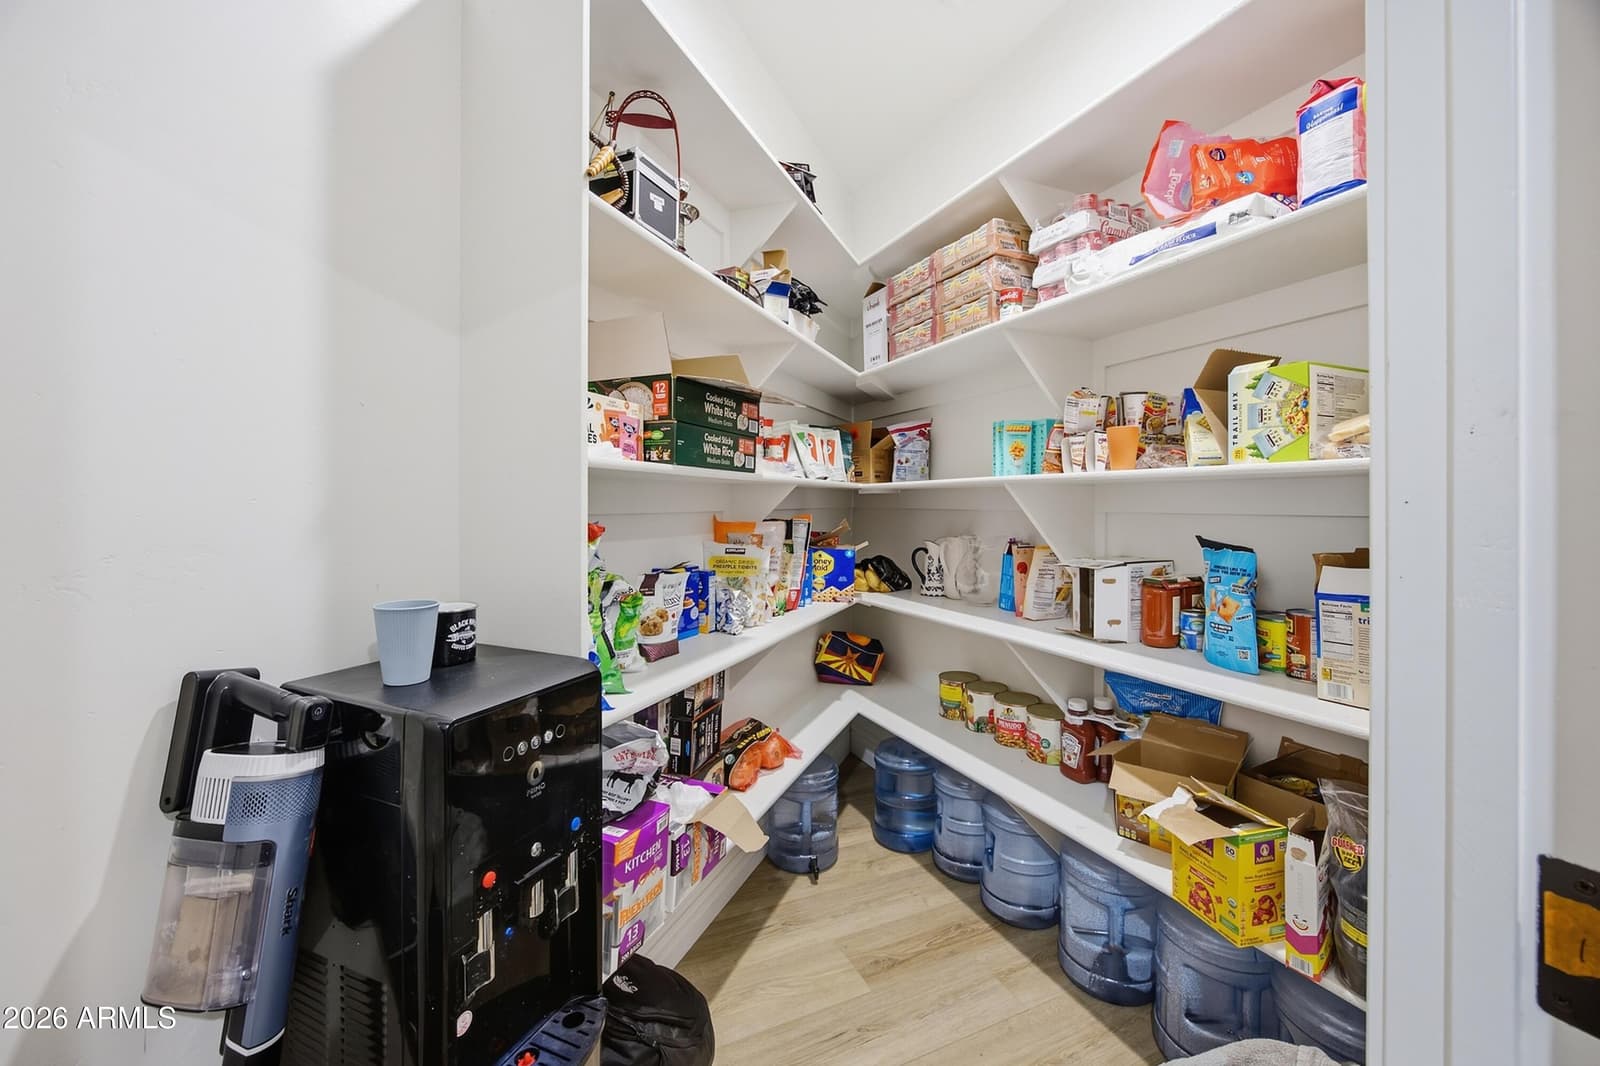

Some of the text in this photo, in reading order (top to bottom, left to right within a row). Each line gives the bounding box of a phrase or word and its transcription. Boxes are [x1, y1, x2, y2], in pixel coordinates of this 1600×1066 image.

[655, 382, 666, 393] 12
[705, 392, 737, 409] Cooked Sticky
[704, 401, 737, 420] White Rice
[704, 432, 734, 447] Cooked Sticky
[703, 442, 734, 458] White Rice
[813, 558, 832, 566] oney
[1358, 616, 1370, 625] tri
[624, 839, 662, 874] KITCHEN
[281, 887, 298, 936] Shark
[626, 923, 639, 942] 13
